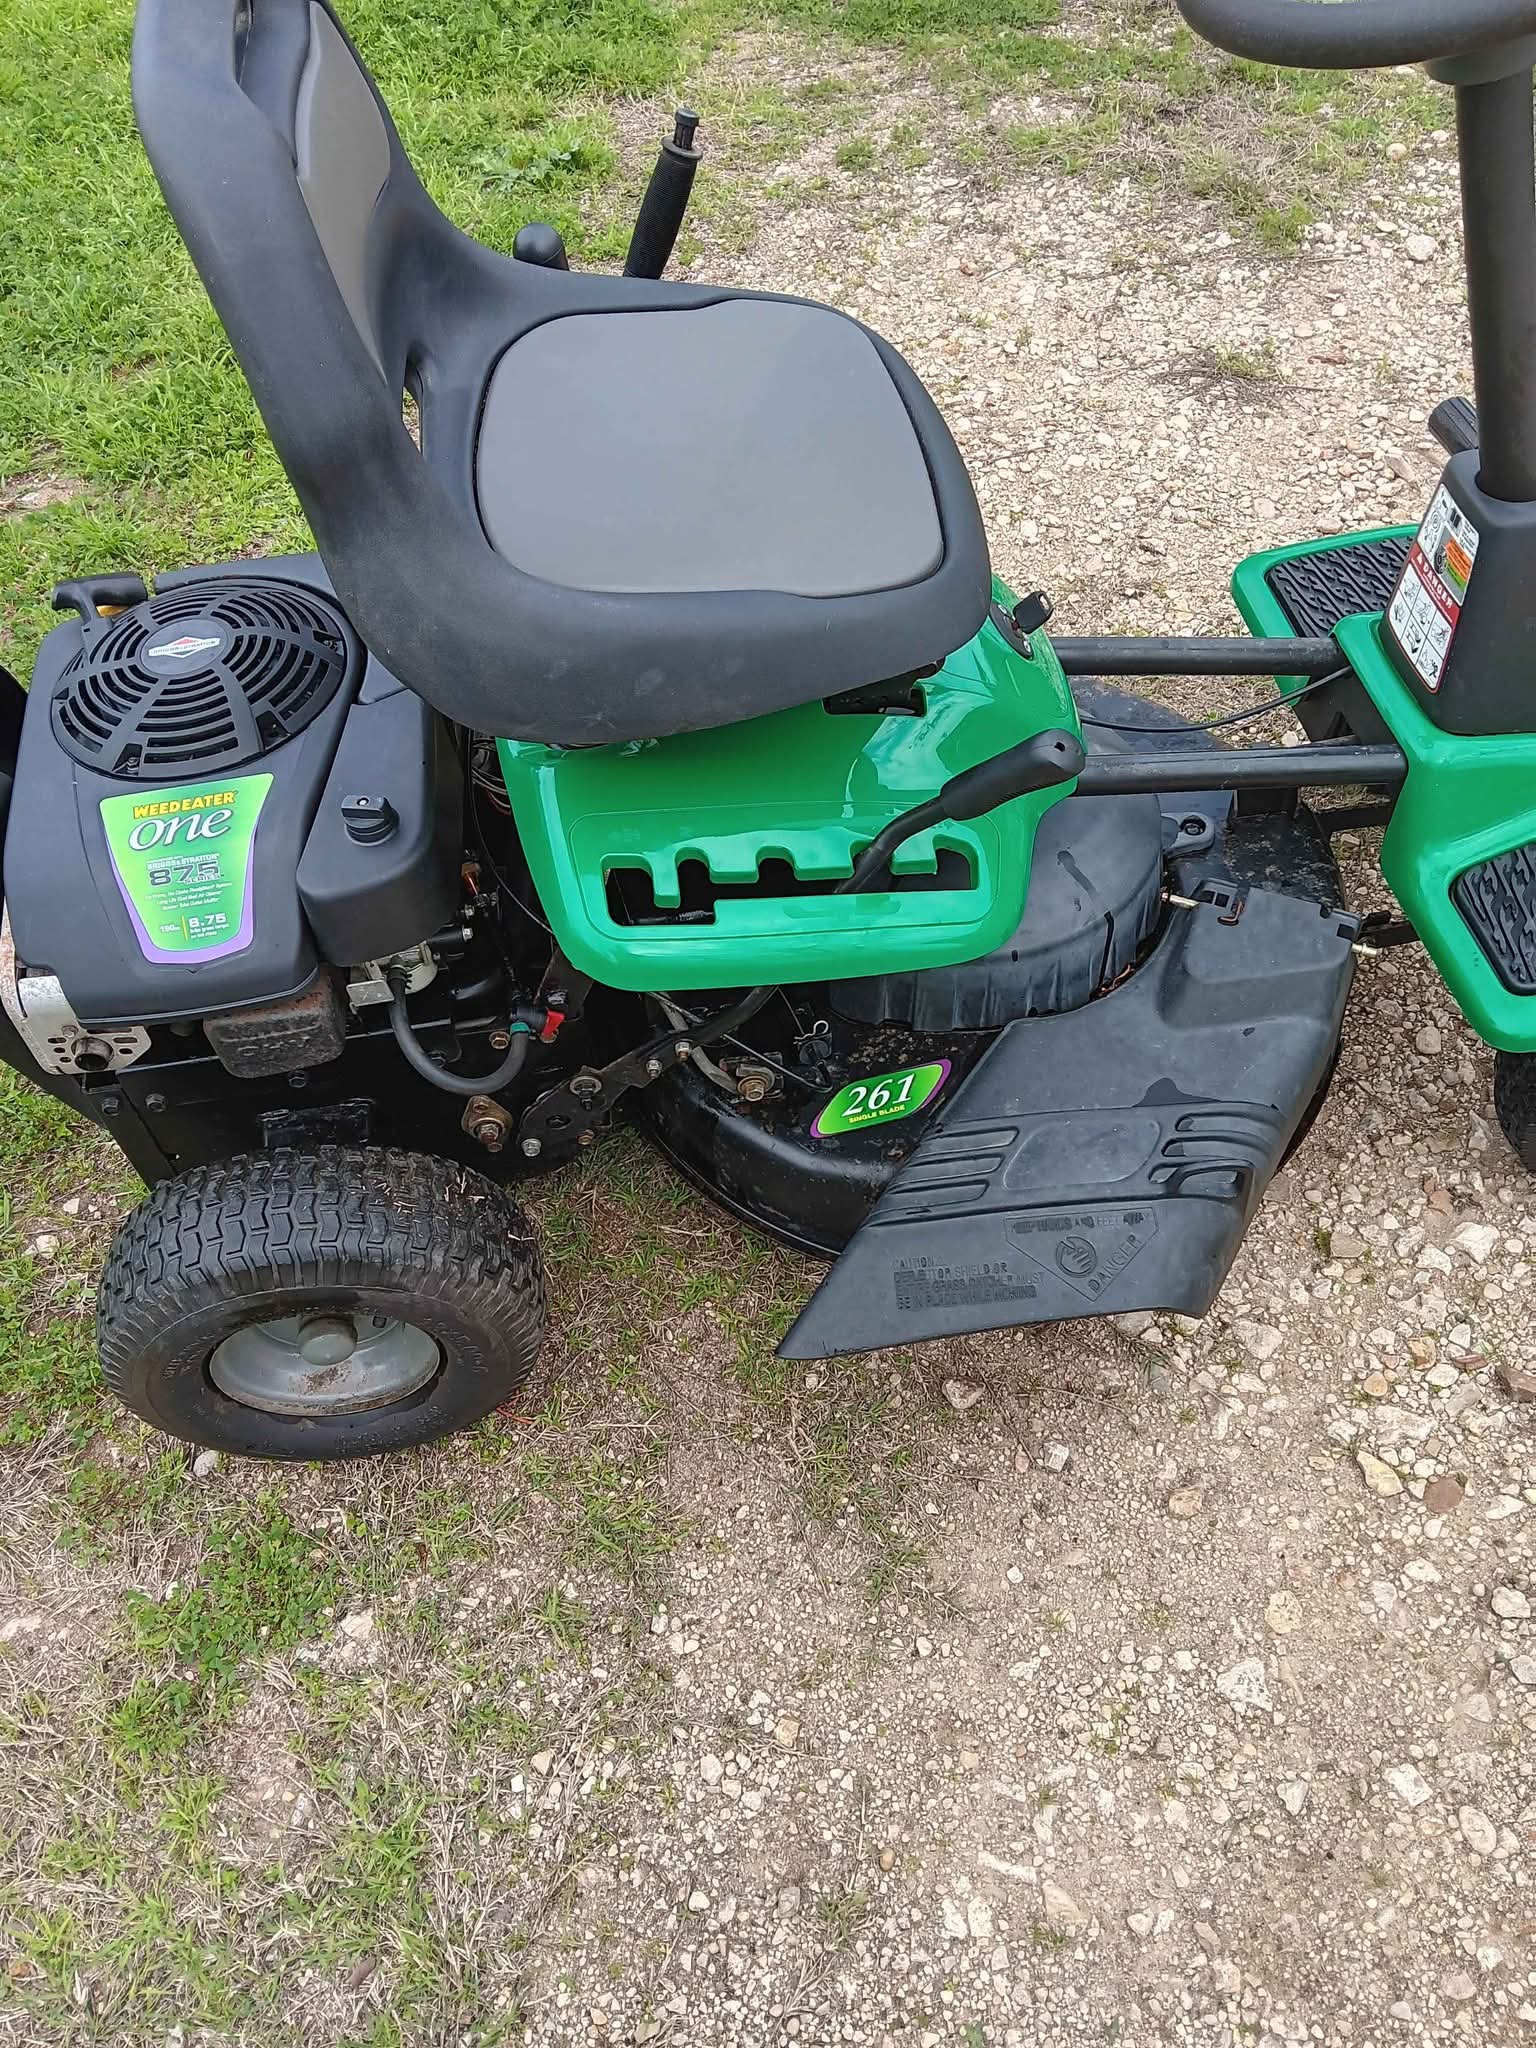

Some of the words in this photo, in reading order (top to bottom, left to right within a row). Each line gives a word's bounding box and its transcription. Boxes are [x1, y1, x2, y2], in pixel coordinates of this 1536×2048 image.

[1422, 559, 1453, 609] DANGER
[128, 808, 233, 850] one
[149, 861, 219, 886] 875
[841, 1072, 915, 1117] 261
[848, 1111, 878, 1123] SINGLE
[878, 1104, 906, 1116] BLADE
[994, 1261, 1009, 1275] OR
[1088, 1233, 1142, 1294] DANGER
